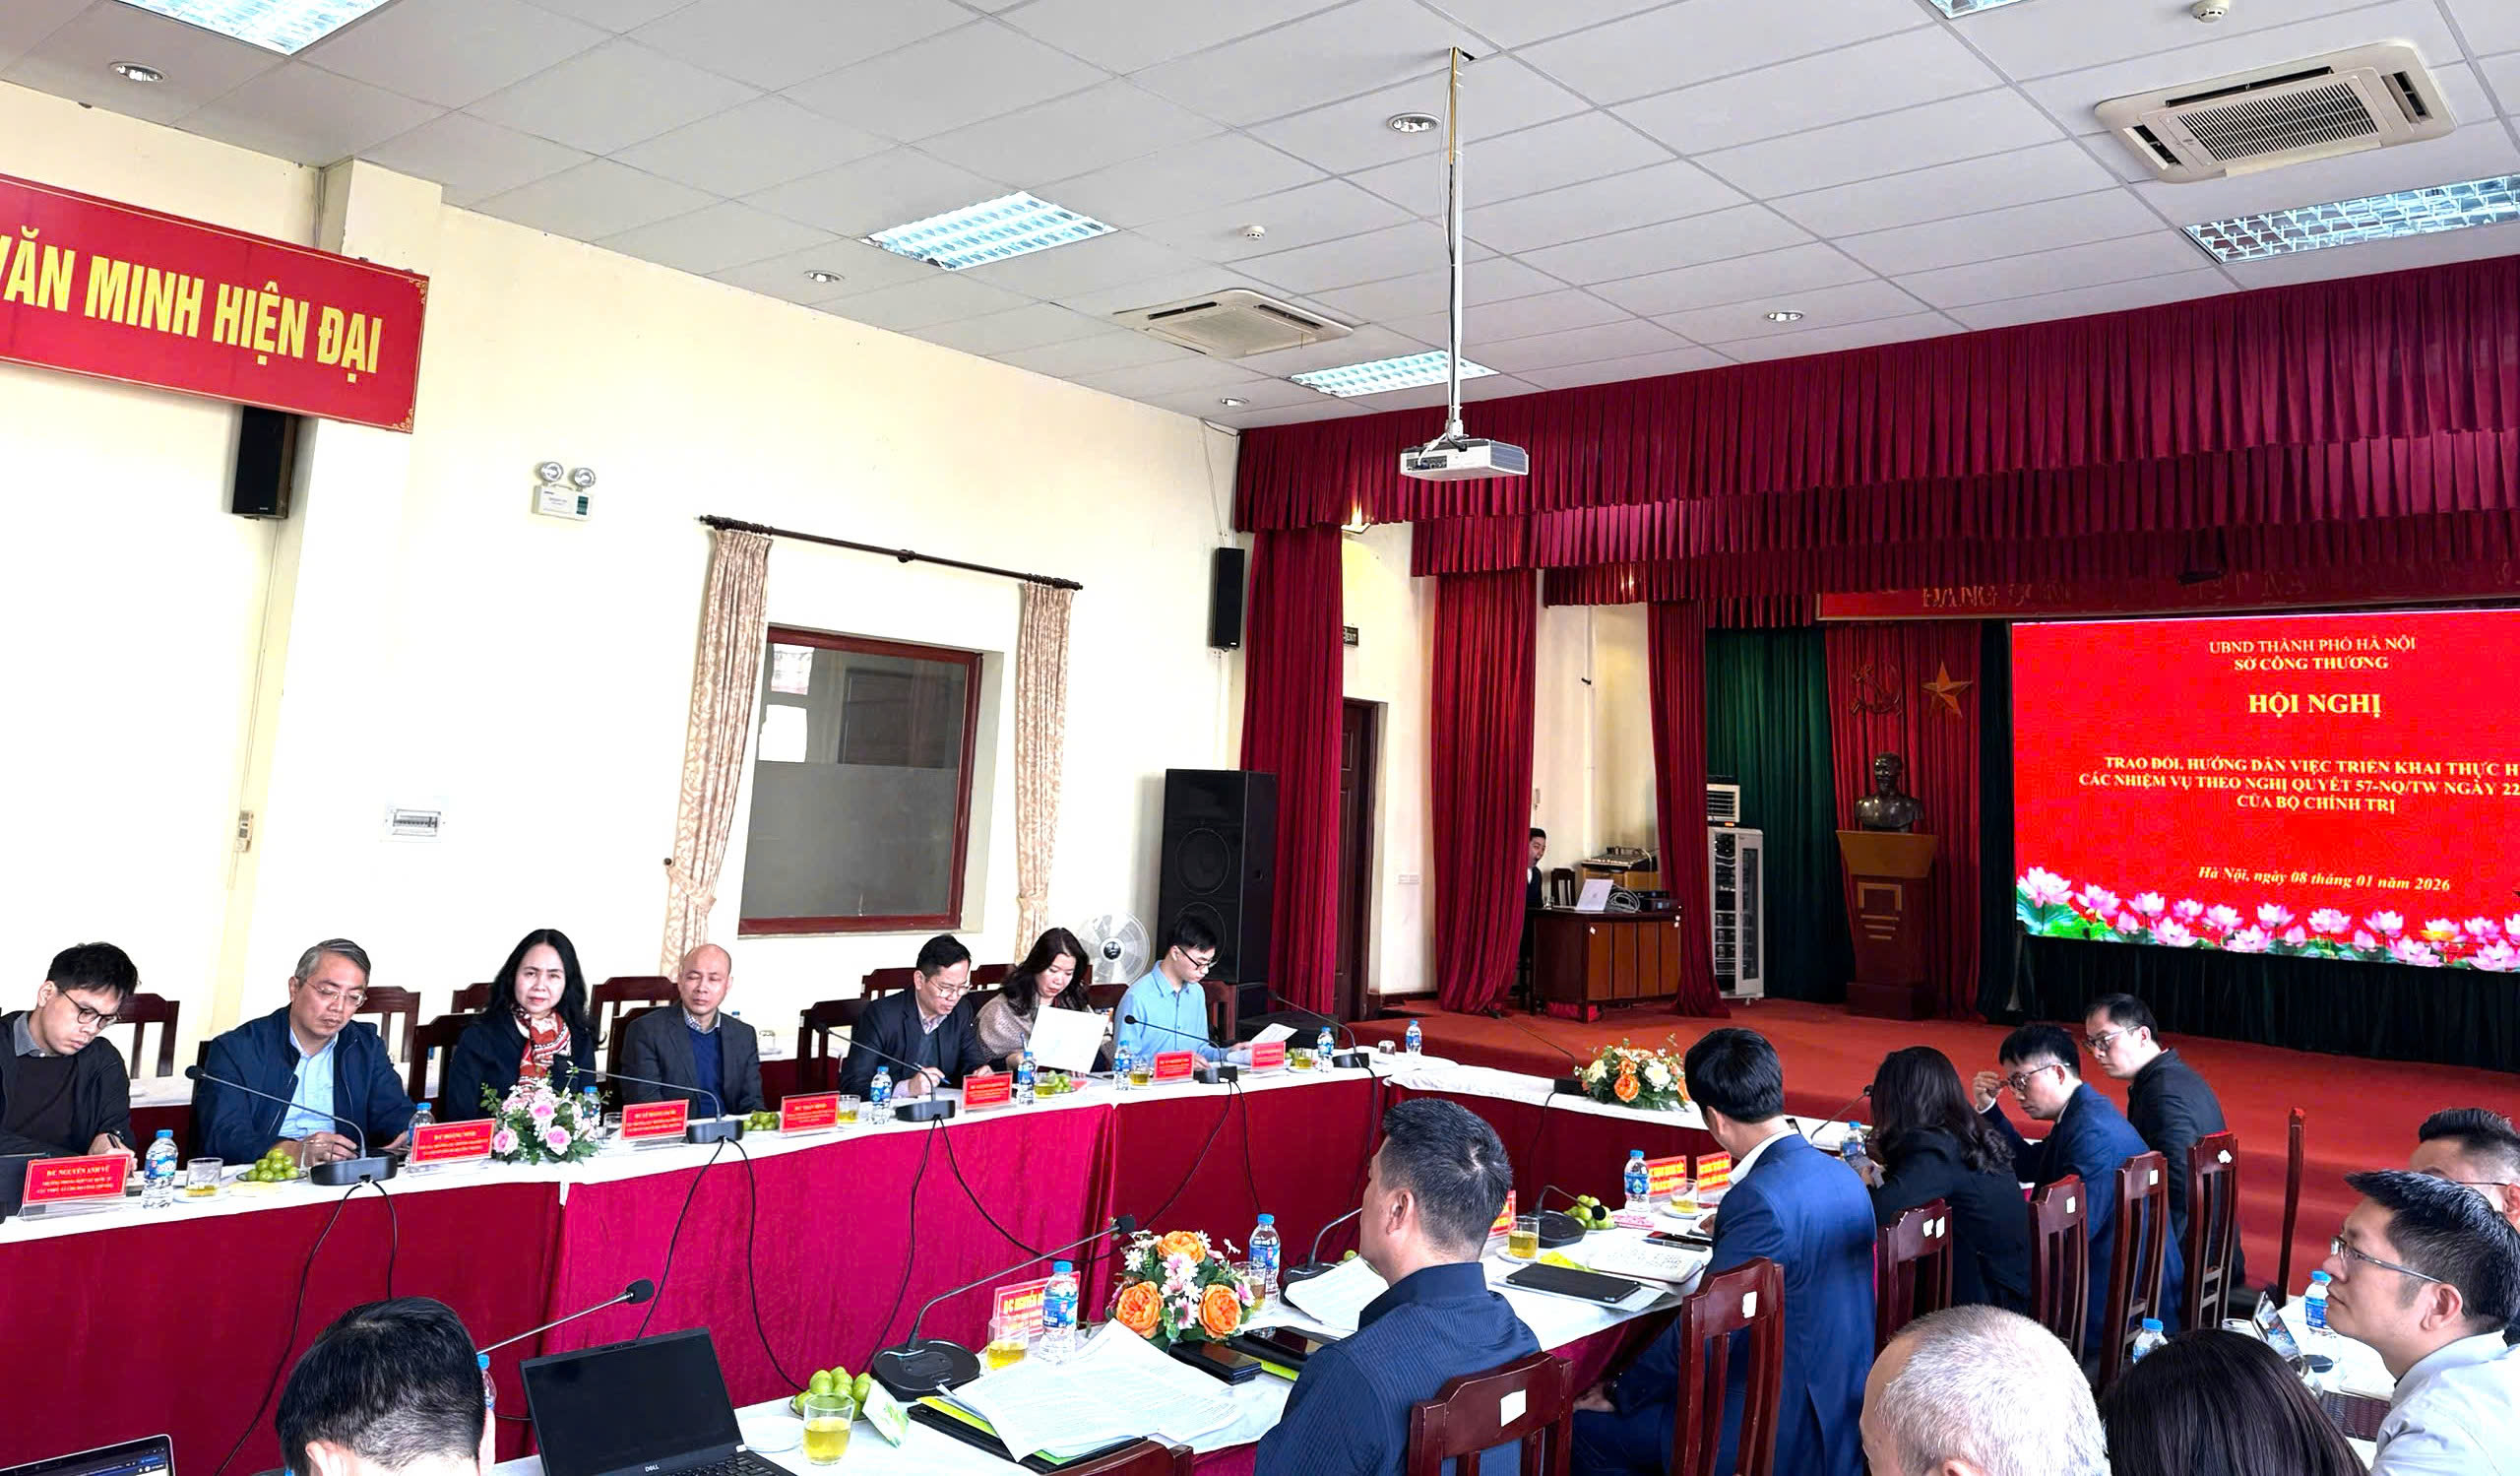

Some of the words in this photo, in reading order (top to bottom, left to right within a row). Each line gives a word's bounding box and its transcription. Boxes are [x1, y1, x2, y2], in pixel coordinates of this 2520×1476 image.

[85, 255, 205, 338] MINH
[213, 280, 309, 365] HIỆN
[317, 305, 383, 383] ĐẠI
[2209, 640, 2254, 654] UBND
[2257, 638, 2313, 653] THÀNH
[2357, 635, 2381, 651] HÀ
[2385, 634, 2416, 652] NỘI
[2259, 655, 2308, 671] CÔNG
[2311, 655, 2389, 670] THƯƠNG
[2248, 691, 2300, 718] HỘI
[2307, 693, 2381, 718] NGHỊ
[2104, 756, 2148, 769] TRAO
[2187, 756, 2247, 771] HƯỚNG
[2290, 758, 2332, 775] VIỆC
[2395, 761, 2441, 775] KHAI
[2446, 761, 2500, 779] THỰC
[2079, 771, 2111, 786] CÁC
[2114, 773, 2166, 789] NHIỆM
[2170, 775, 2191, 790] VỤ
[2195, 776, 2241, 789] THEO
[2245, 777, 2287, 793] NGHỊ
[2356, 779, 2437, 795] 57-NQ/TW
[2444, 779, 2496, 796] NGÀY
[2276, 795, 2300, 811] BỘ
[2303, 794, 2361, 810] CHÍNH
[2364, 798, 2395, 814] TRỊ
[2198, 866, 2219, 879] Hà
[2254, 869, 2288, 886] ngày
[2291, 871, 2308, 884] 08
[2310, 872, 2352, 888] tháng
[2357, 873, 2373, 887] 01
[2414, 877, 2450, 891] 2026
